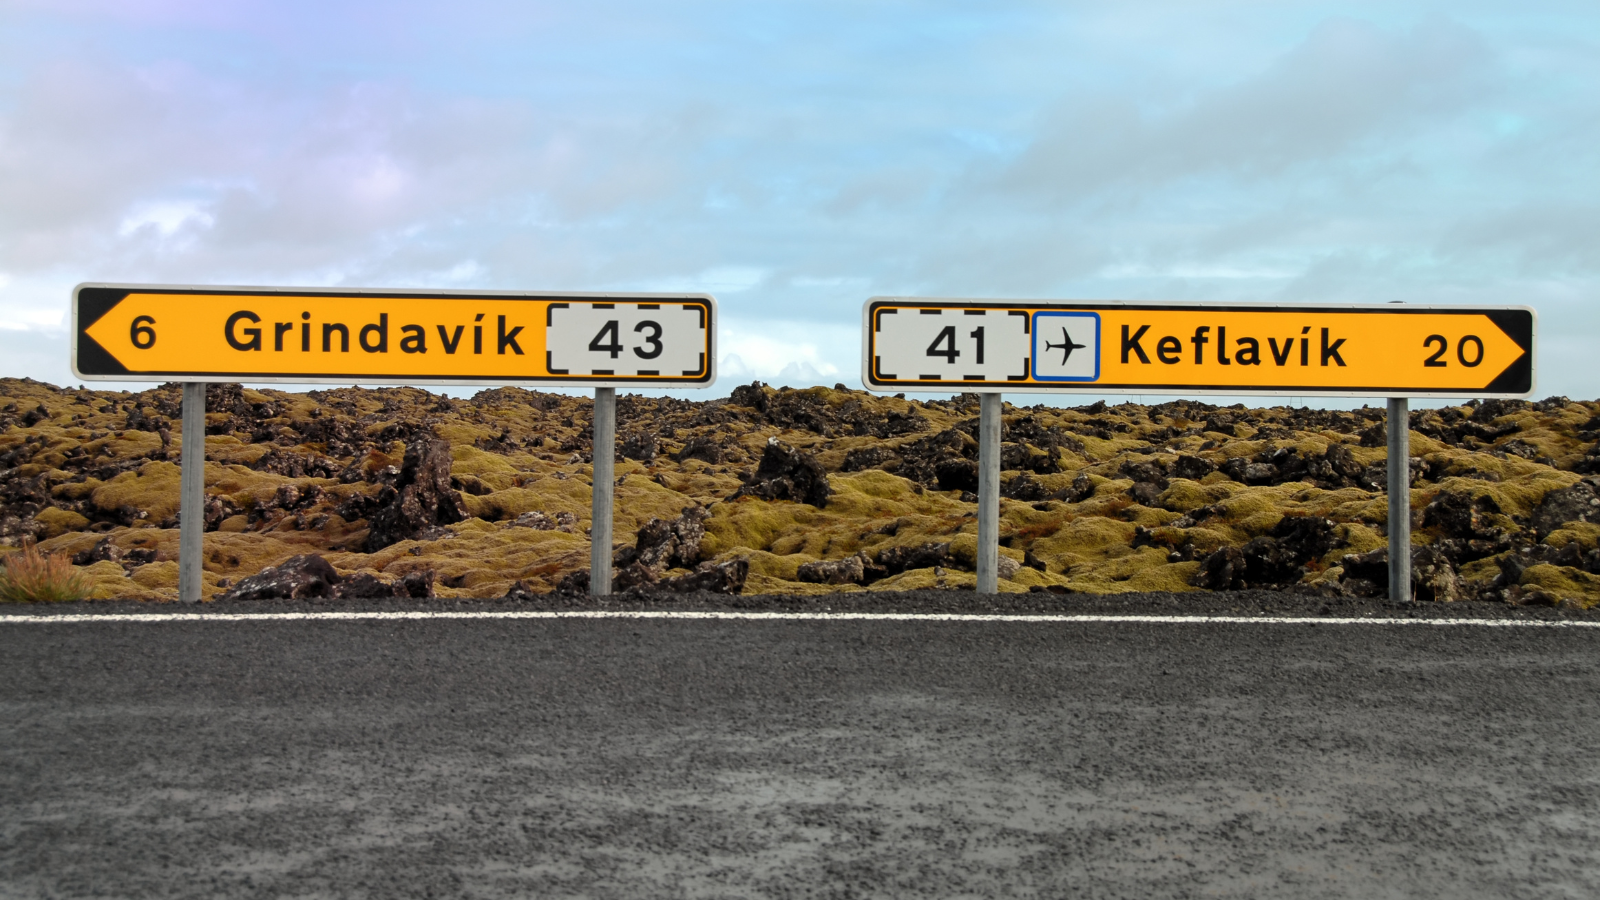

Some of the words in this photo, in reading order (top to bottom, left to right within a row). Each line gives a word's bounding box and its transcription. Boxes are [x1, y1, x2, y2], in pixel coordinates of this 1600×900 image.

[130, 315, 156, 350] 6
[224, 310, 524, 356] Grindavík
[588, 320, 664, 360] 43
[926, 325, 985, 365] 41
[1121, 325, 1347, 367] Keflavík
[1423, 334, 1484, 368] 20
